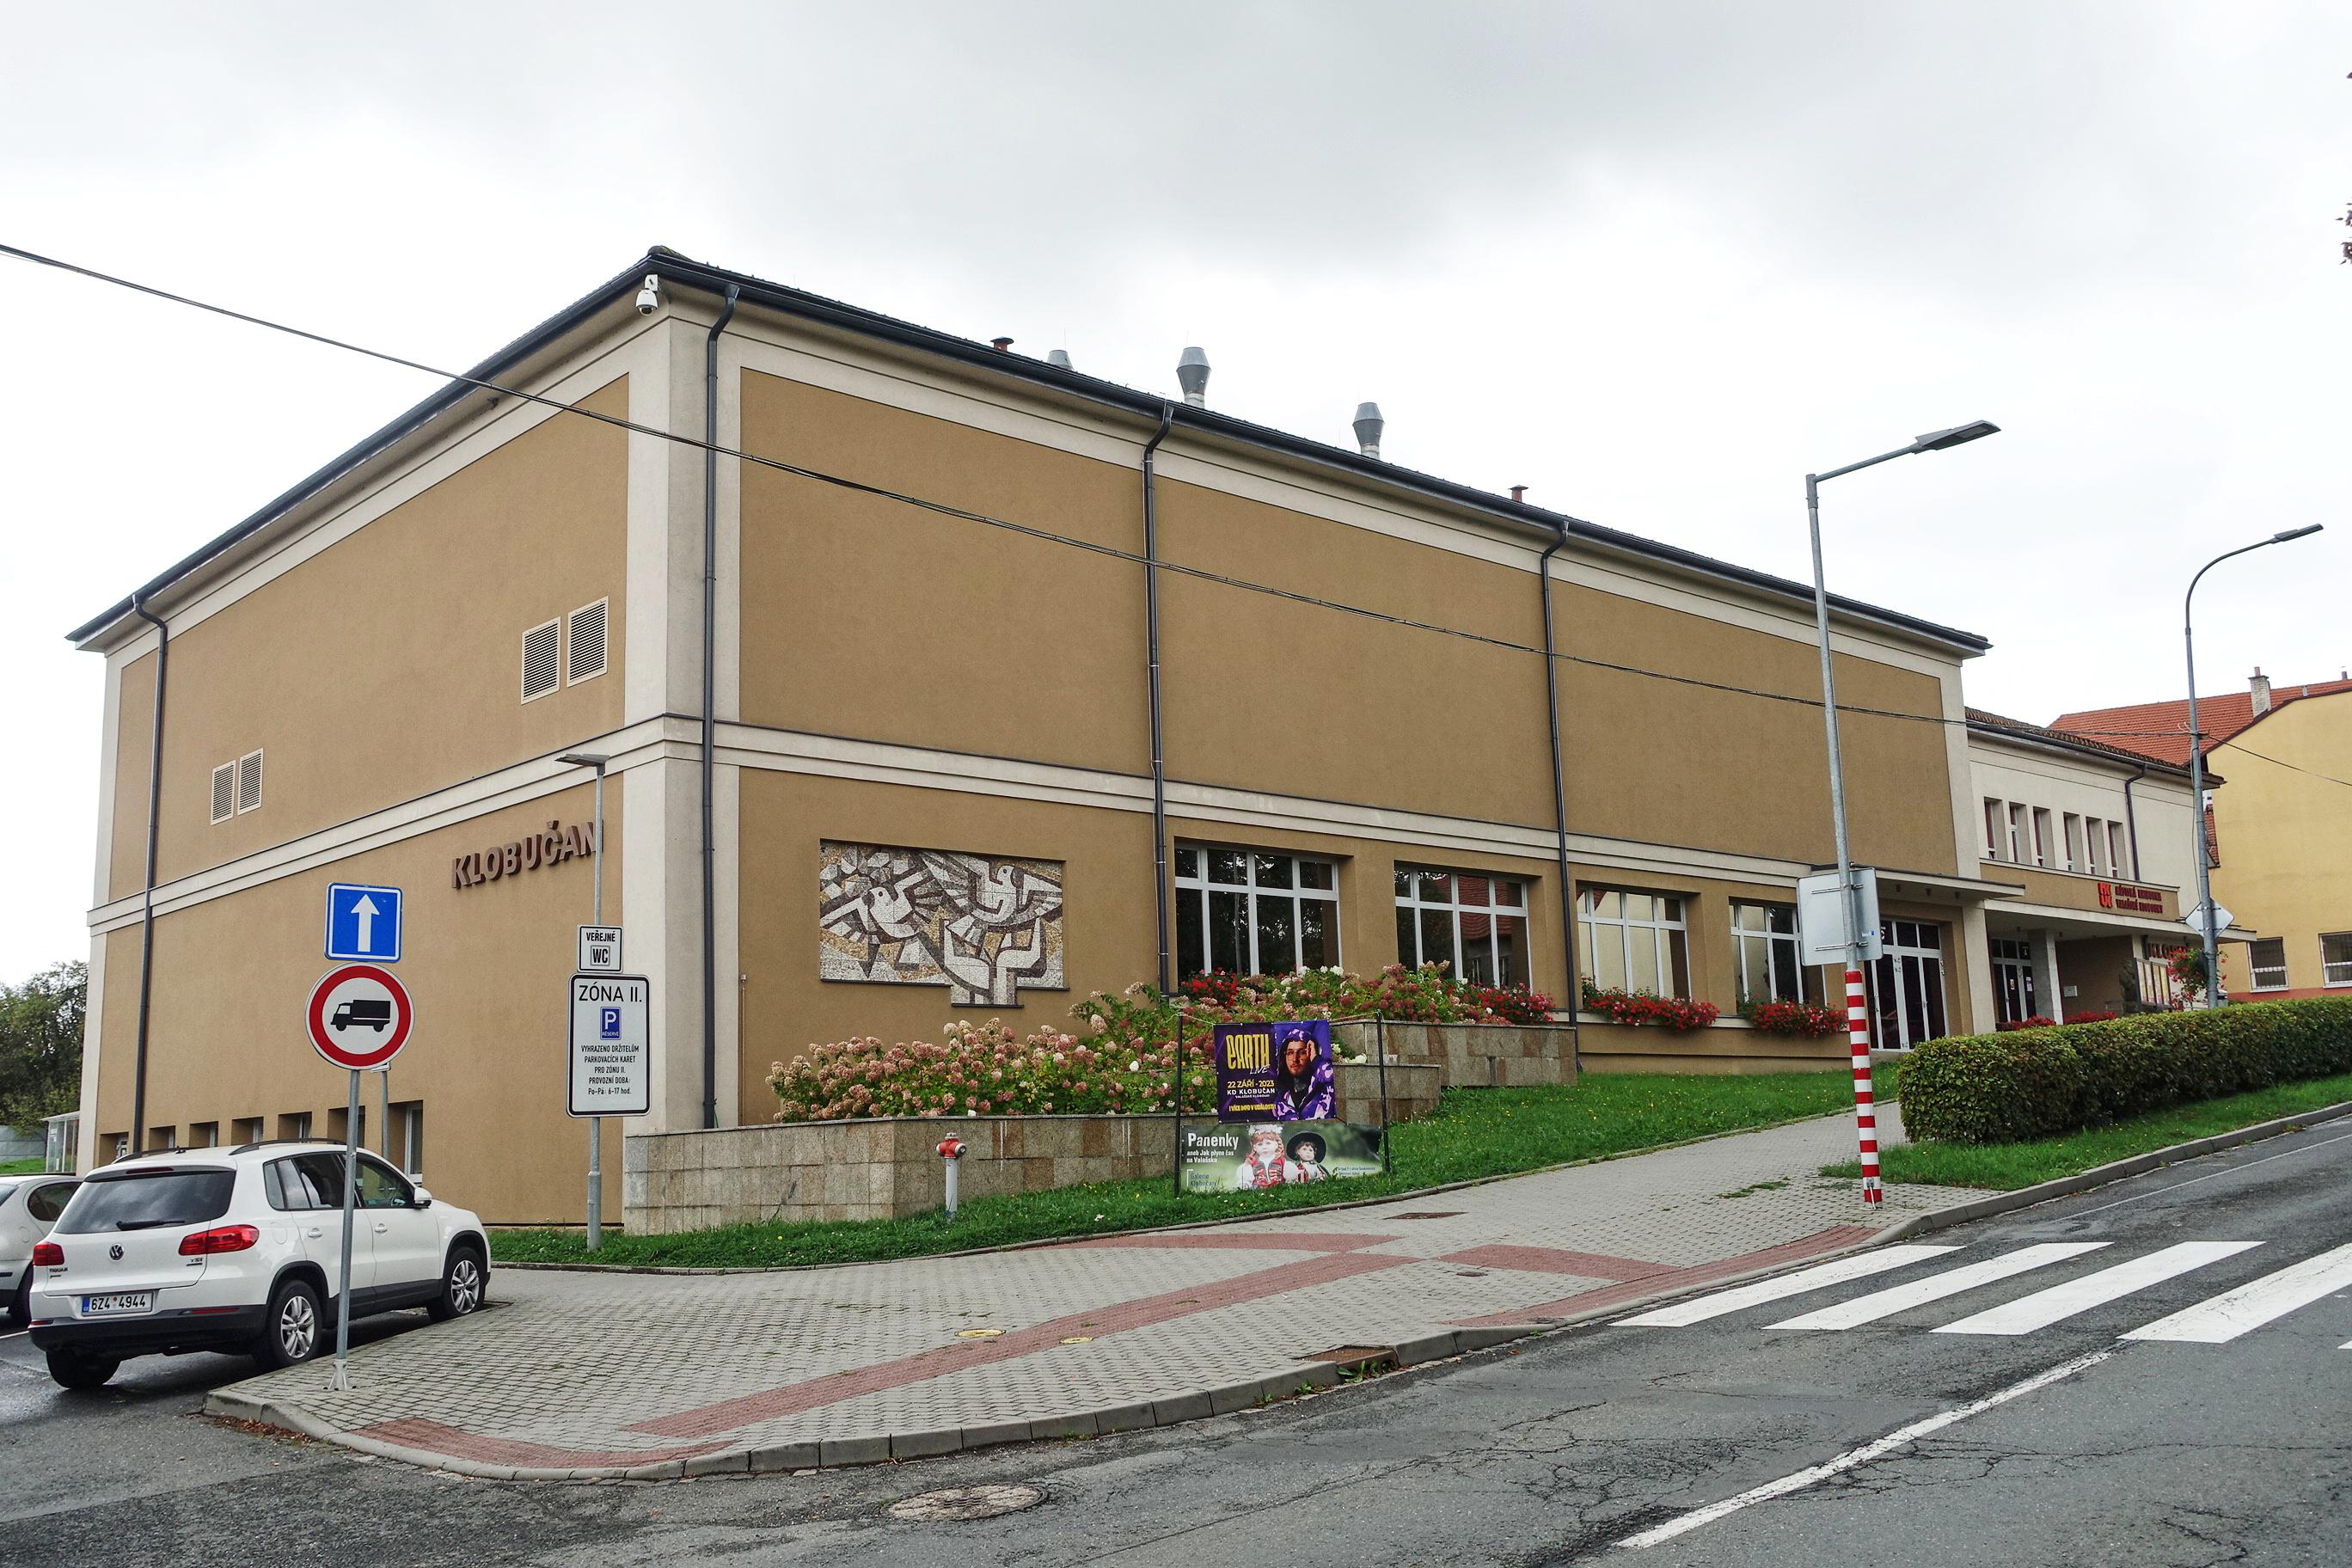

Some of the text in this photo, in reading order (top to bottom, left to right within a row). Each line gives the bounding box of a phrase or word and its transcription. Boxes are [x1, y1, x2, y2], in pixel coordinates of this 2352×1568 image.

[452, 819, 603, 889] KLOBUČAN
[586, 929, 616, 942] VEŘEJNÉ
[592, 948, 609, 964] WC
[579, 982, 642, 1002] ZÓNA II.
[604, 1011, 617, 1030] P
[581, 1044, 640, 1053] VYHRAZENO DRŽITELŮM
[584, 1054, 618, 1063] PARKOVACÍCH
[606, 1065, 620, 1074] ZÓNU
[1250, 1064, 1271, 1075] LIVE
[589, 1075, 614, 1084] PROVOZNÍ
[1237, 1079, 1254, 1088] ZÁŘÍ
[1239, 1087, 1276, 1095] KLOBUČAN
[1187, 1132, 1239, 1150] Panenky
[91, 1297, 110, 1311] 6Z4
[119, 1295, 145, 1308] 4944
